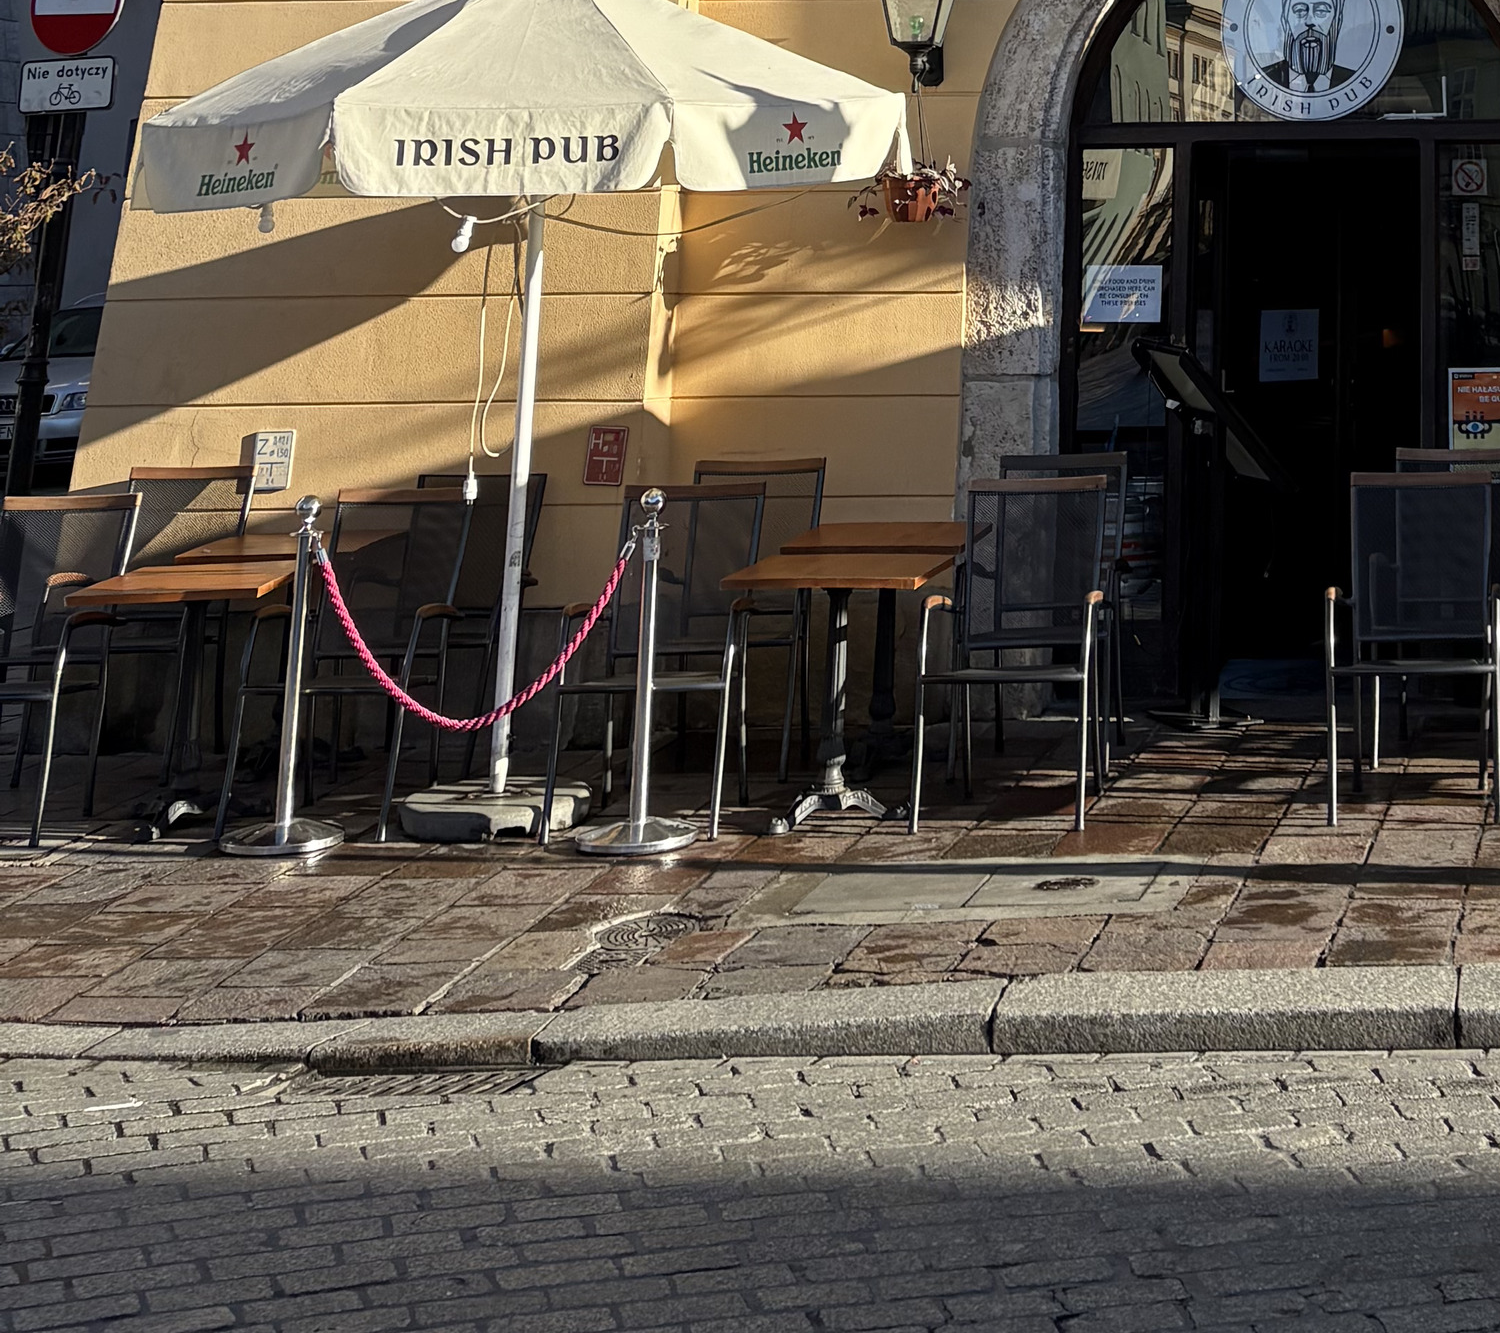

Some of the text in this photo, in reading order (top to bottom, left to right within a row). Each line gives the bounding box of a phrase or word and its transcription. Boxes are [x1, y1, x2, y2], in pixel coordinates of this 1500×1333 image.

[27, 65, 109, 81] Nie dotyczy
[1247, 76, 1373, 114] IRISH PUB
[394, 134, 620, 167] IRISH PUB
[748, 147, 842, 174] Heineken
[196, 168, 276, 197] Heineken
[1264, 339, 1313, 353] KARAOKE
[1457, 385, 1471, 393] NIE
[1479, 395, 1490, 403] BE
[591, 432, 604, 450] H
